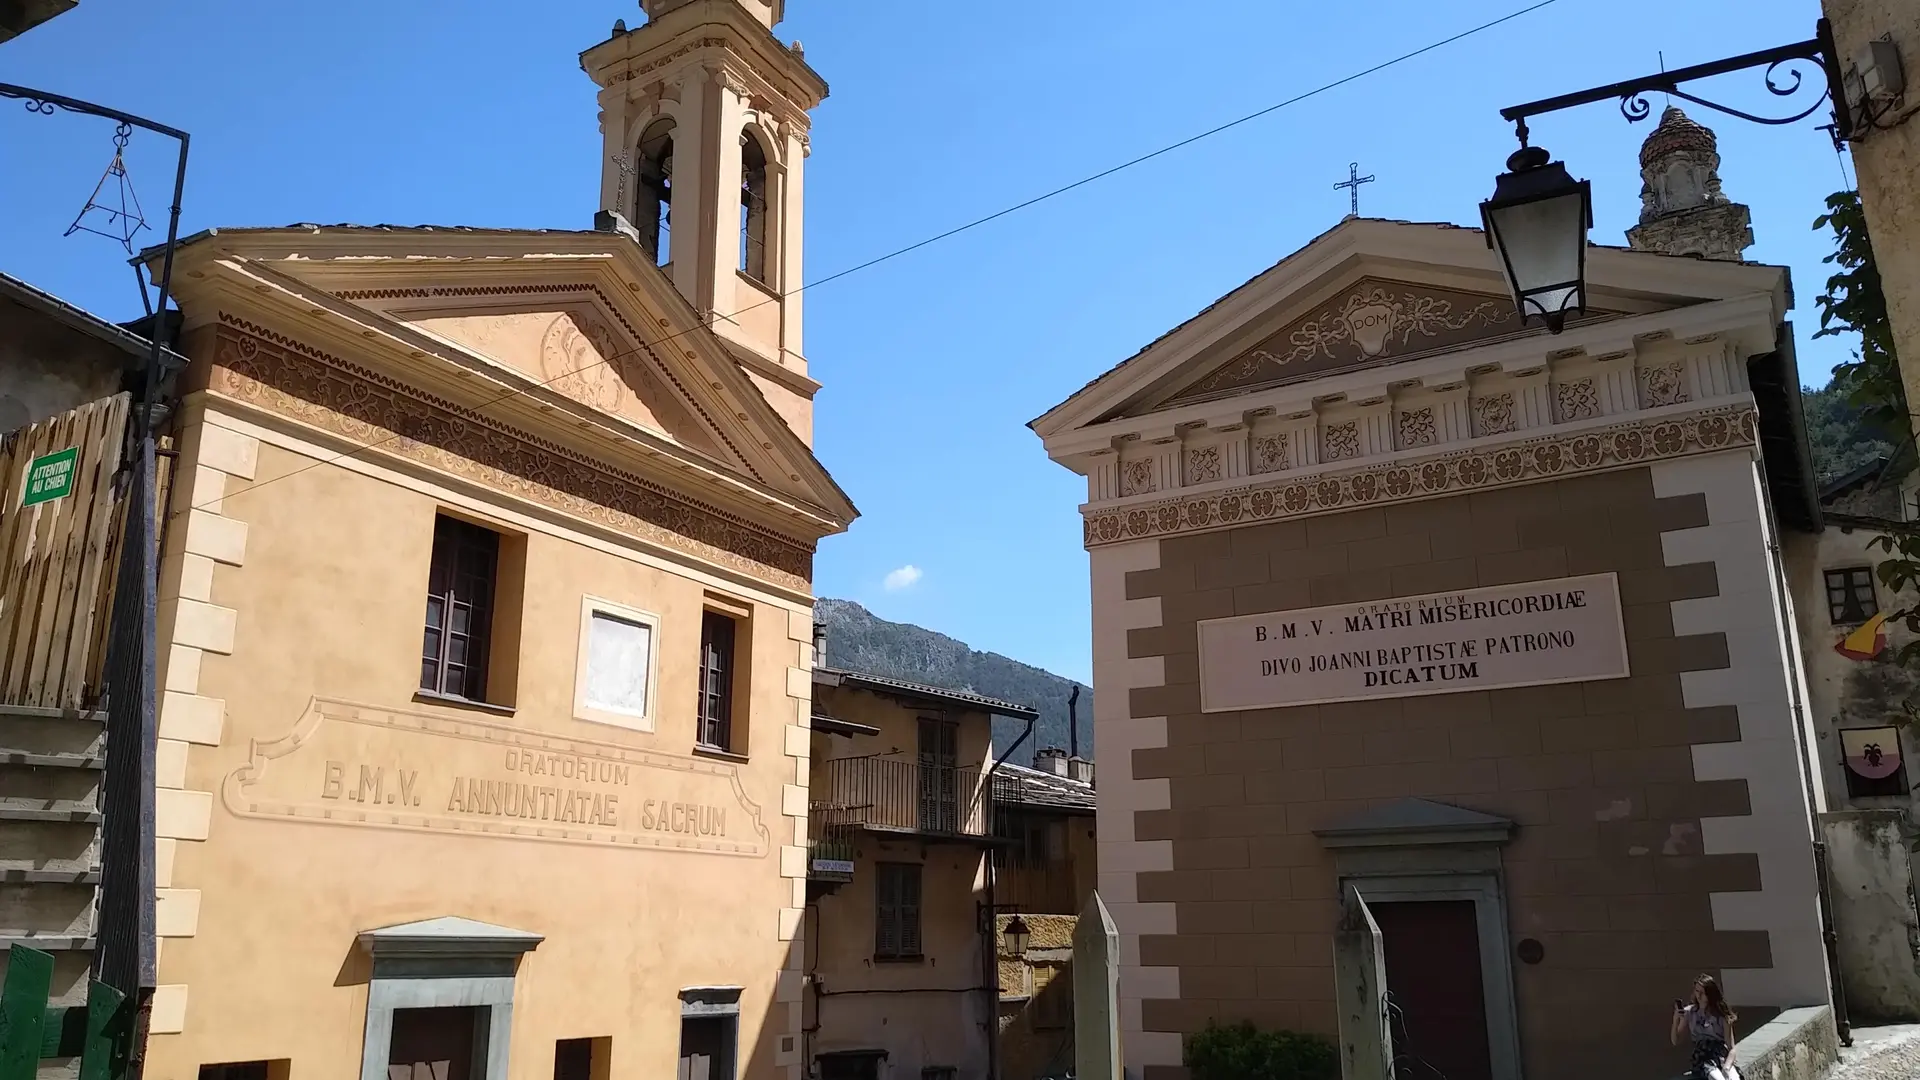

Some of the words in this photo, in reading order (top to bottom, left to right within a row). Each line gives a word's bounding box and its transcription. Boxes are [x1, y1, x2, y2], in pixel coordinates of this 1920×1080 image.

[1353, 313, 1387, 330] DOM
[31, 458, 72, 481] ATTENTION
[31, 479, 43, 494] AU
[44, 473, 67, 491] CHIEN
[1358, 595, 1466, 615] ORATORIUM
[1344, 610, 1412, 633] MATRI
[1261, 657, 1301, 677] DIVO
[1308, 650, 1371, 673] JOANNI
[1485, 630, 1574, 656] PATRONO
[1364, 661, 1479, 687] DICATUM
[505, 748, 630, 785] ORATORIUM
[447, 777, 618, 827] ANNUNTIATAE
[642, 799, 726, 837] SACRUM
